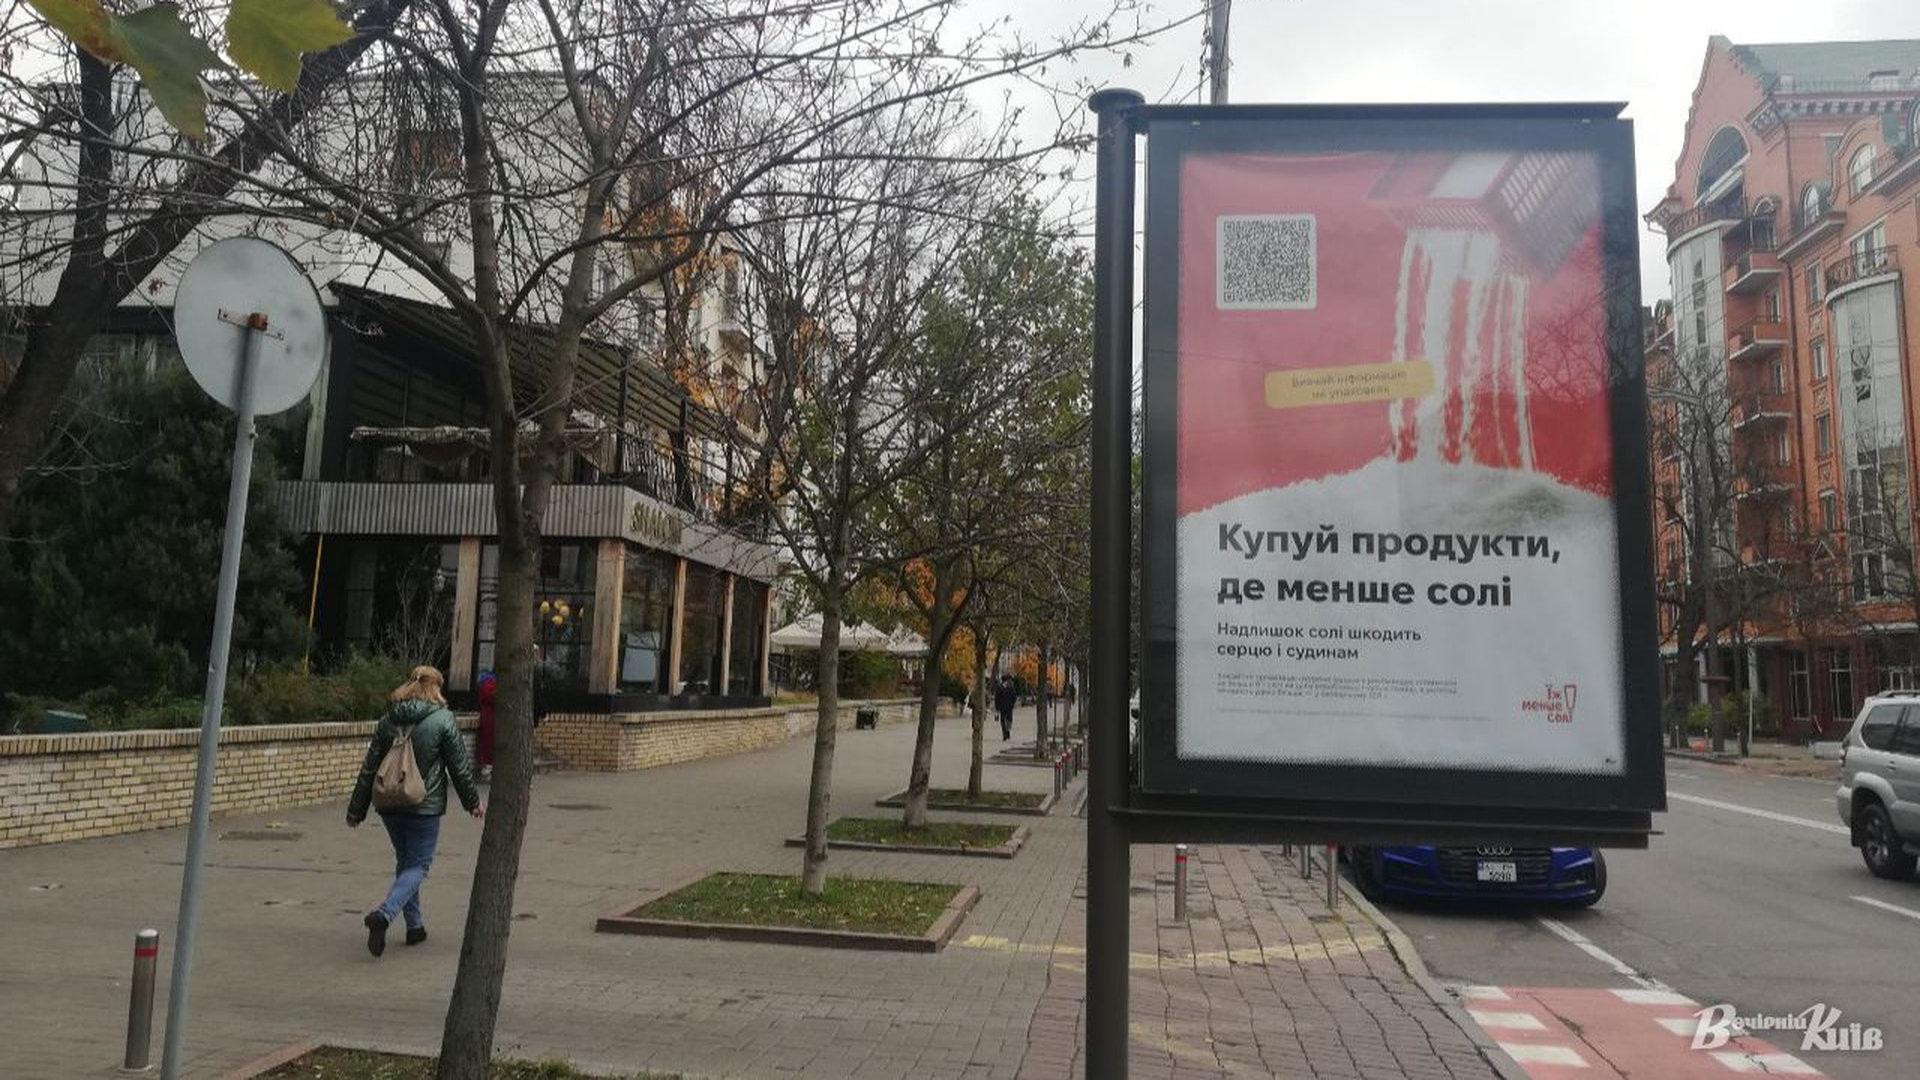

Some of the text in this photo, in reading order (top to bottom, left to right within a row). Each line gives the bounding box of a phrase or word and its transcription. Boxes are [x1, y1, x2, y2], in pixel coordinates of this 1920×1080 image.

[1218, 523, 1561, 564] Купуй продукти,
[1217, 575, 1512, 607] де менше солі
[1217, 622, 1422, 643] Надлишок солі шкодить
[1217, 643, 1359, 661] серцю і судинам
